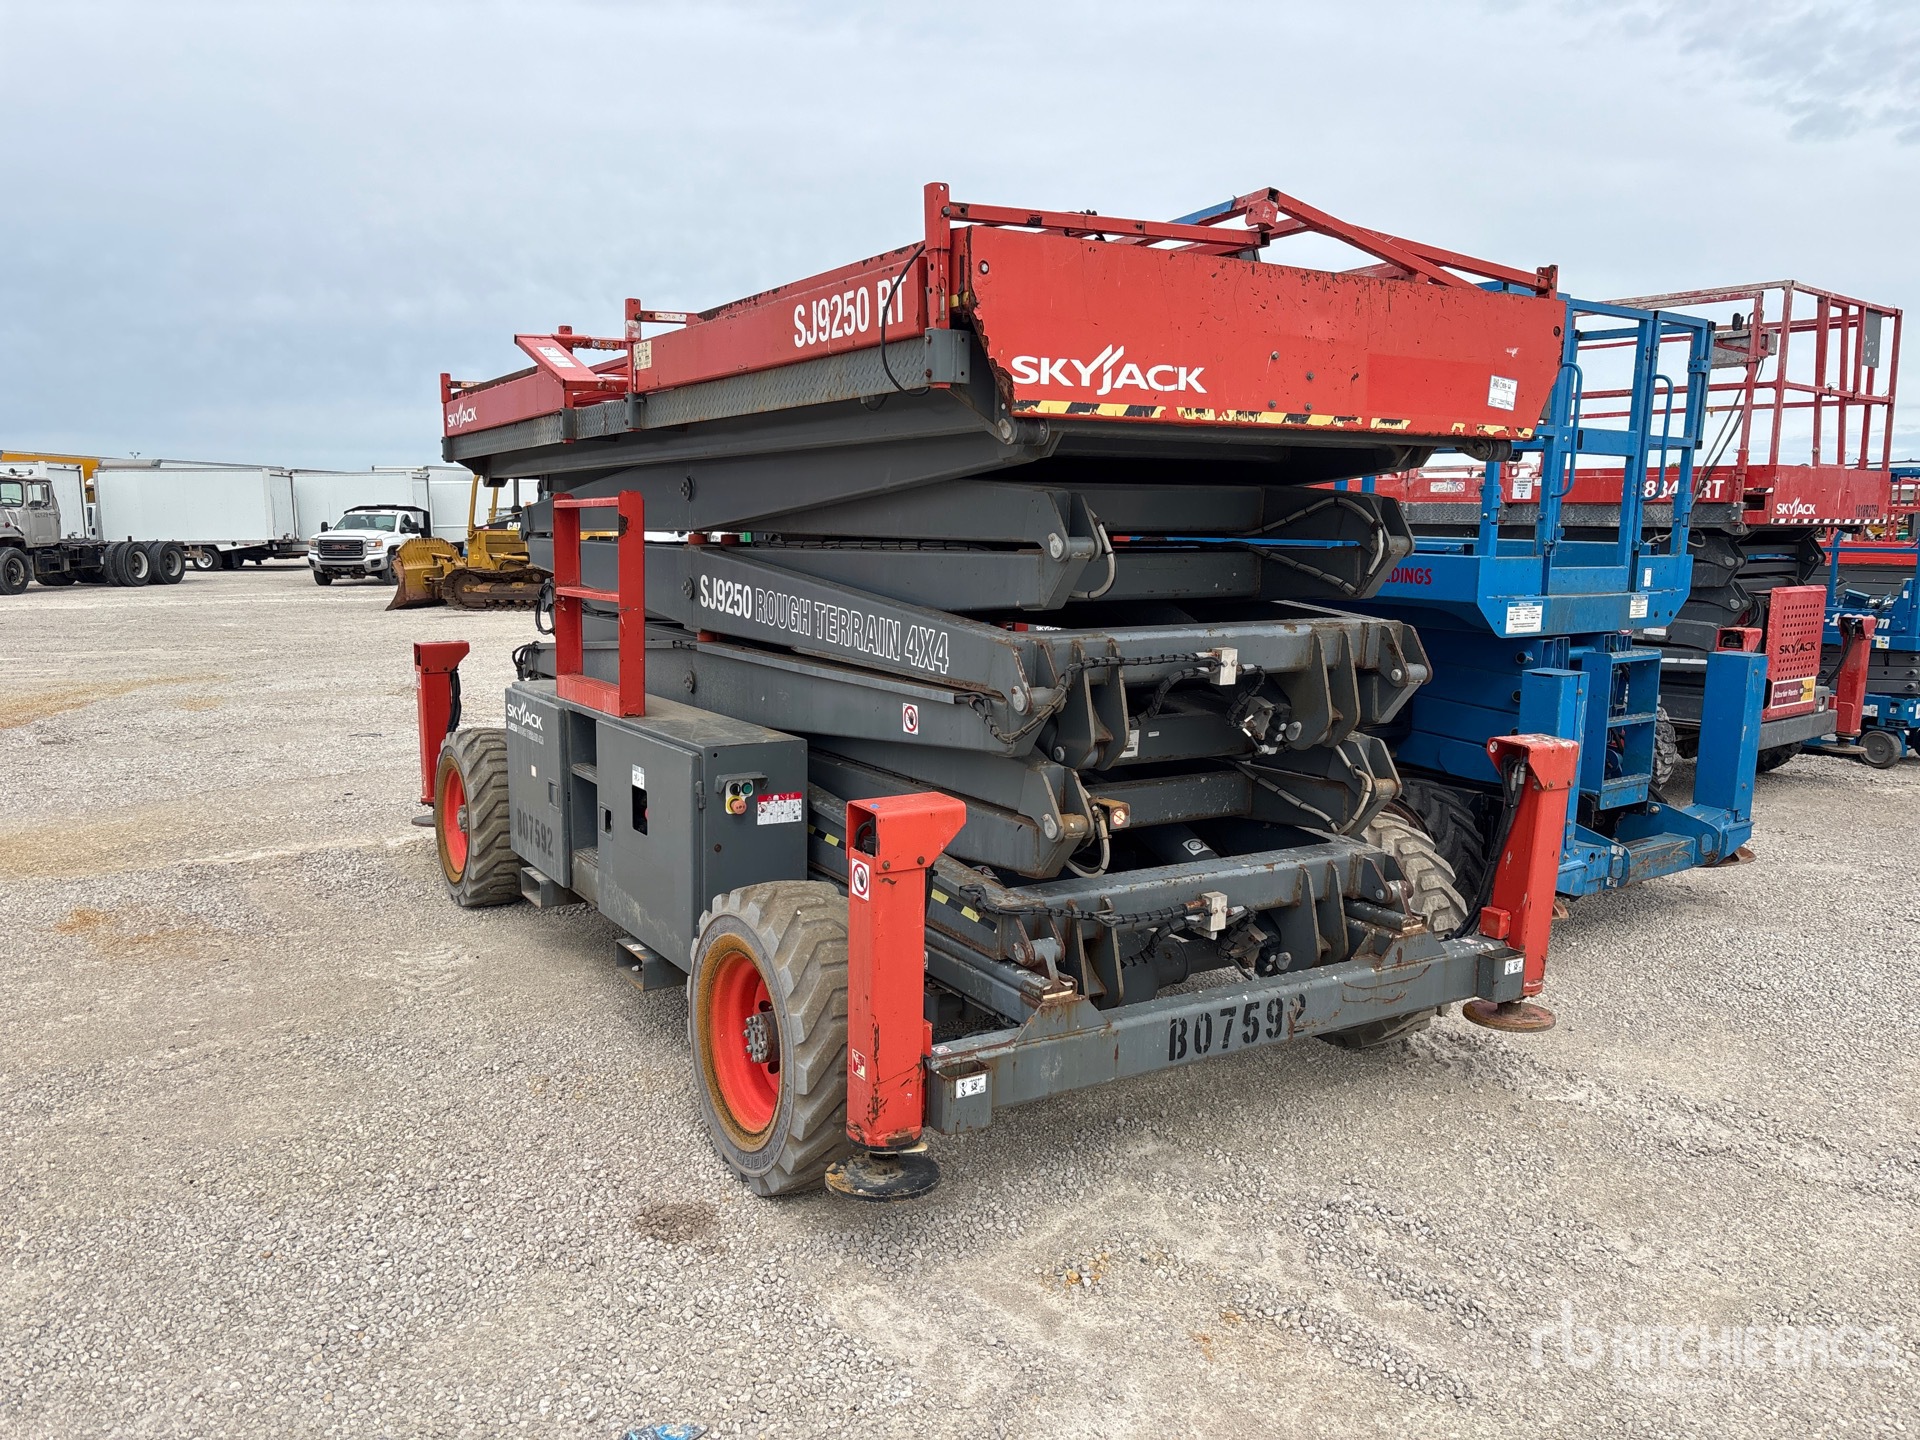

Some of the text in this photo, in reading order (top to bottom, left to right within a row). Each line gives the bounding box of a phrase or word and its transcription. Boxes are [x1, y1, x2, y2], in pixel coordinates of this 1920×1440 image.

[794, 274, 907, 348] SJ9250 RT
[1011, 344, 1208, 395] SKYJACK
[447, 402, 478, 428] SKYJACK
[1776, 497, 1817, 517] SKYJACK
[1385, 567, 1432, 585] DINGS
[700, 574, 950, 675] SJ9250 ROUGH TERRAIN 4X4
[1779, 638, 1816, 656] SKYJACK
[507, 701, 544, 731] SKYJACK
